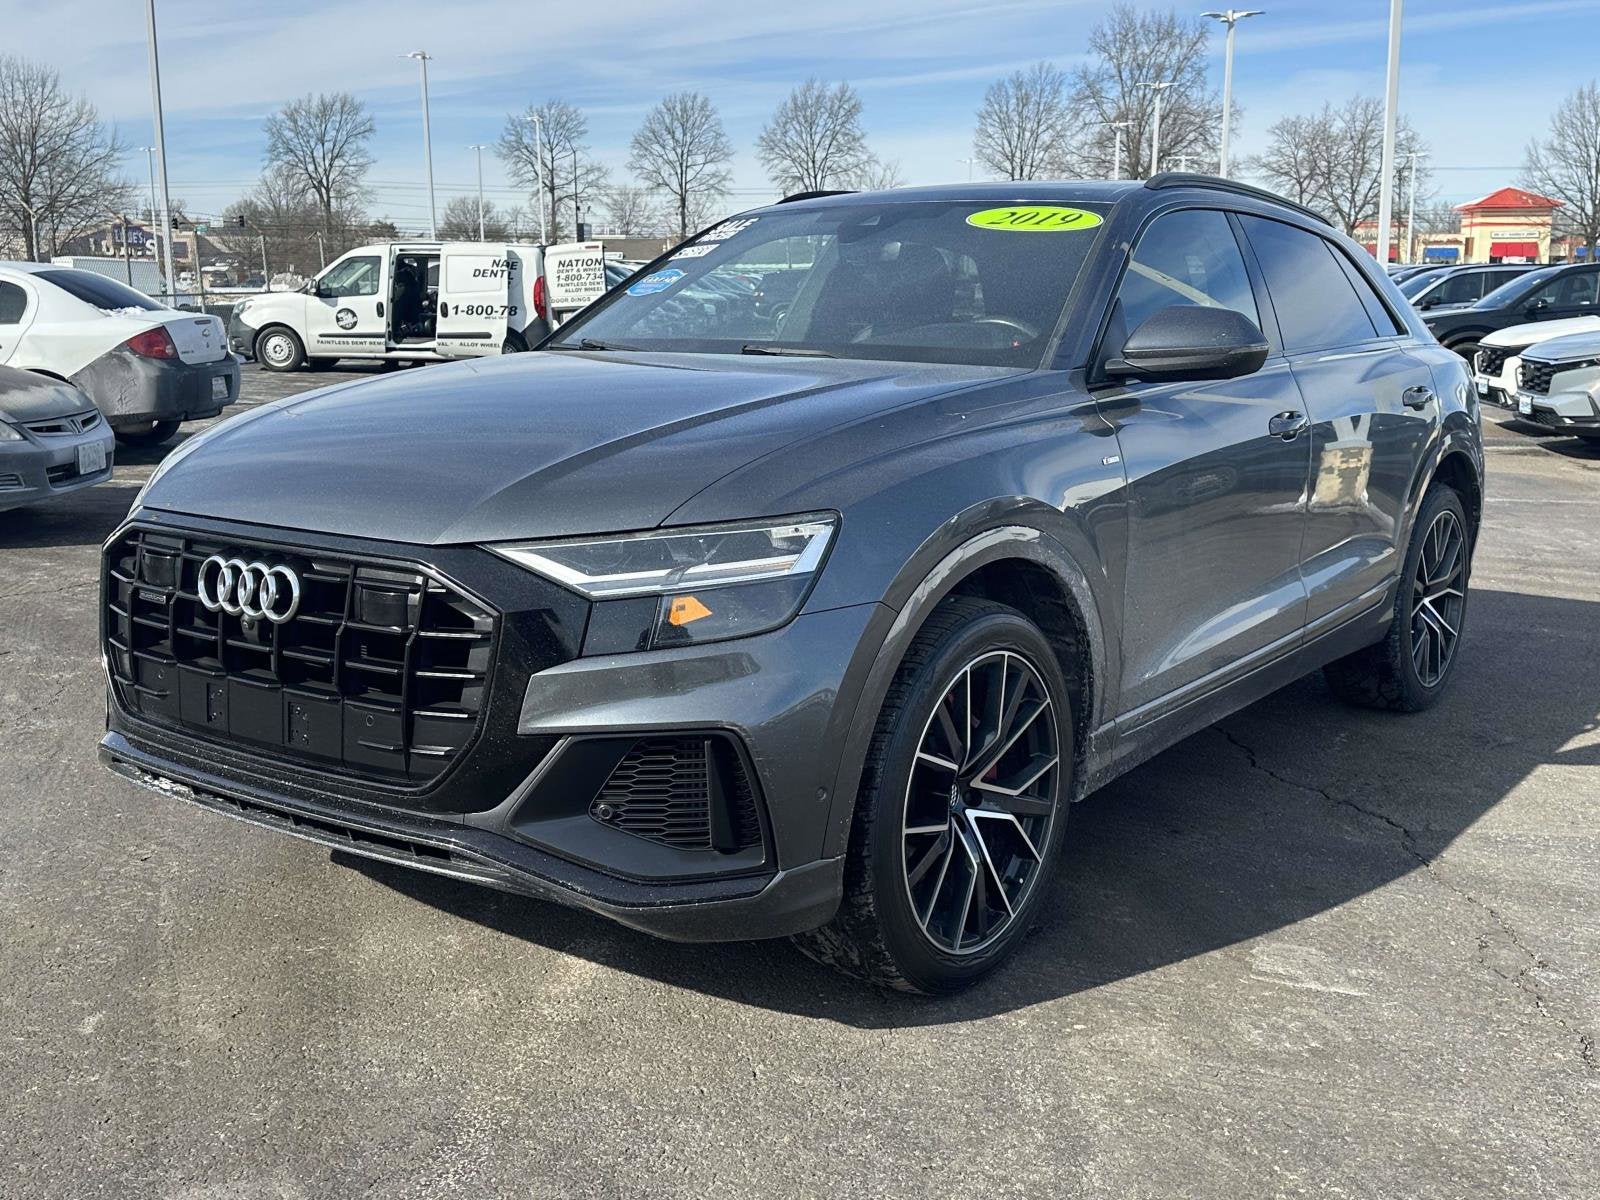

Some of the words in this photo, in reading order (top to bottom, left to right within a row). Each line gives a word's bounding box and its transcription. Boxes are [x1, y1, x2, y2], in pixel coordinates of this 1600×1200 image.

[986, 211, 1083, 226] 2019
[557, 257, 603, 268] NATION
[556, 272, 604, 282] 1-800-734
